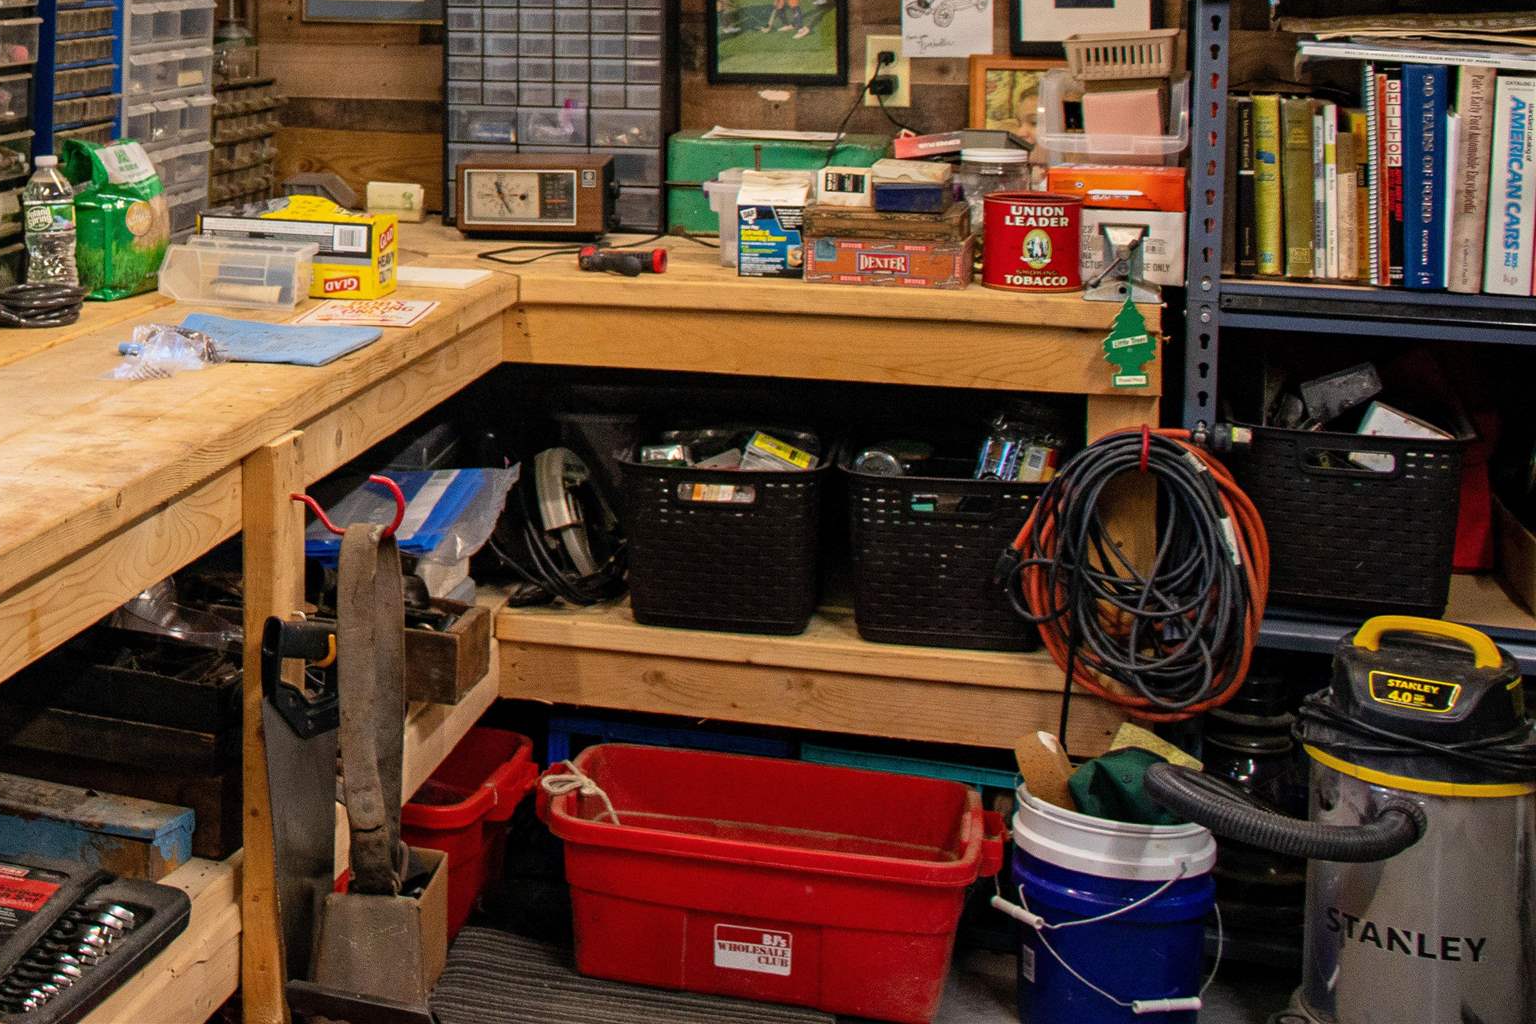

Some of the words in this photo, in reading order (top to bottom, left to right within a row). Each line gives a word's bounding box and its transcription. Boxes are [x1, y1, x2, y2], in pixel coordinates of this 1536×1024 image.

[1422, 74, 1435, 96] 90
[1470, 74, 1485, 95] Pate's
[1468, 97, 1483, 113] Early
[1388, 80, 1401, 166] CHILTON
[1422, 100, 1435, 152] YEARS
[1469, 115, 1482, 130] Ford
[1466, 133, 1480, 169] Automobile
[1506, 95, 1526, 201] AMERICAN
[1422, 155, 1434, 176] OF
[1422, 181, 1434, 224] FORD
[1463, 171, 1479, 215] Encyclopedia
[1004, 215, 1069, 227] LEADER
[1010, 205, 1064, 217] UNION
[1504, 201, 1521, 251] CARS
[380, 227, 395, 251] GLAD
[859, 254, 906, 273] DEXTER
[1152, 263, 1171, 273] ONLY
[324, 277, 359, 291] GLAD
[1004, 274, 1068, 286] TOBACCO
[1387, 678, 1441, 695] STANLEY
[1387, 690, 1413, 703] 4.0
[1325, 906, 1488, 963] STANLEY
[717, 942, 790, 958] WHOLESALE
[757, 956, 789, 968] CLUB
